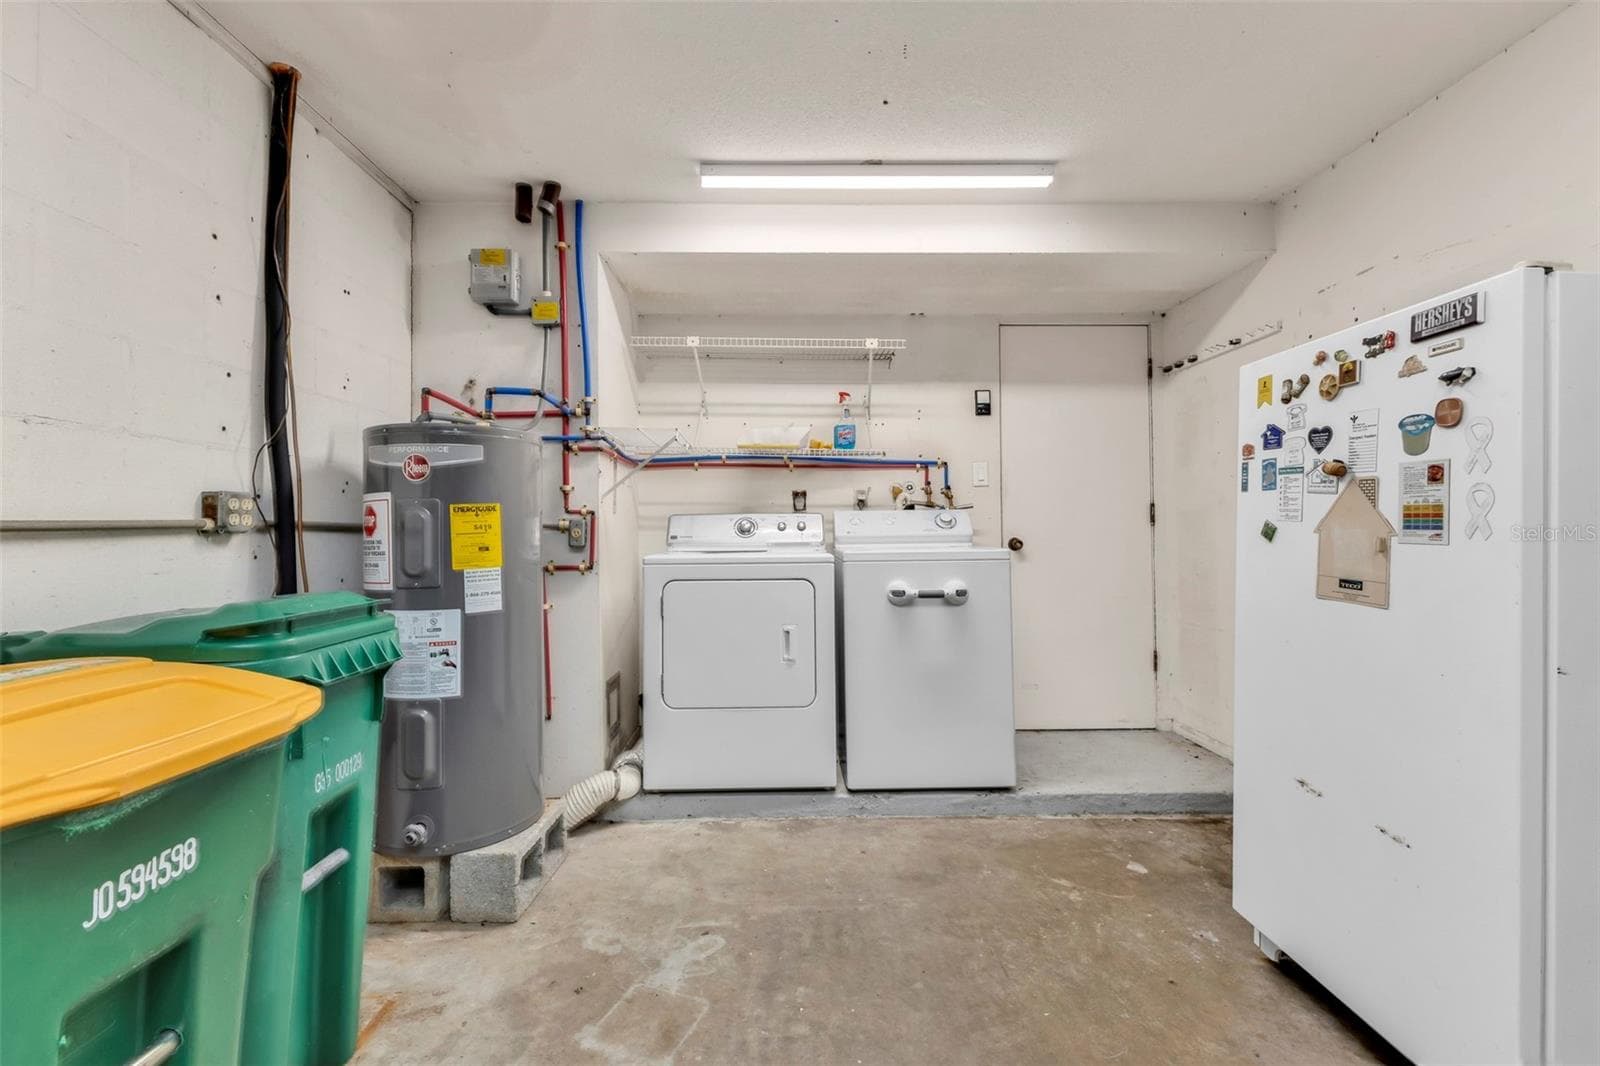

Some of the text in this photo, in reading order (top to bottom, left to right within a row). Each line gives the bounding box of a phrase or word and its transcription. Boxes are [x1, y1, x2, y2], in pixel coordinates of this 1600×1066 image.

[1414, 296, 1473, 333] HERSHEY'S
[389, 445, 449, 453] PERFORMANCE
[405, 454, 428, 478] Rheem
[117, 837, 198, 908] 594598
